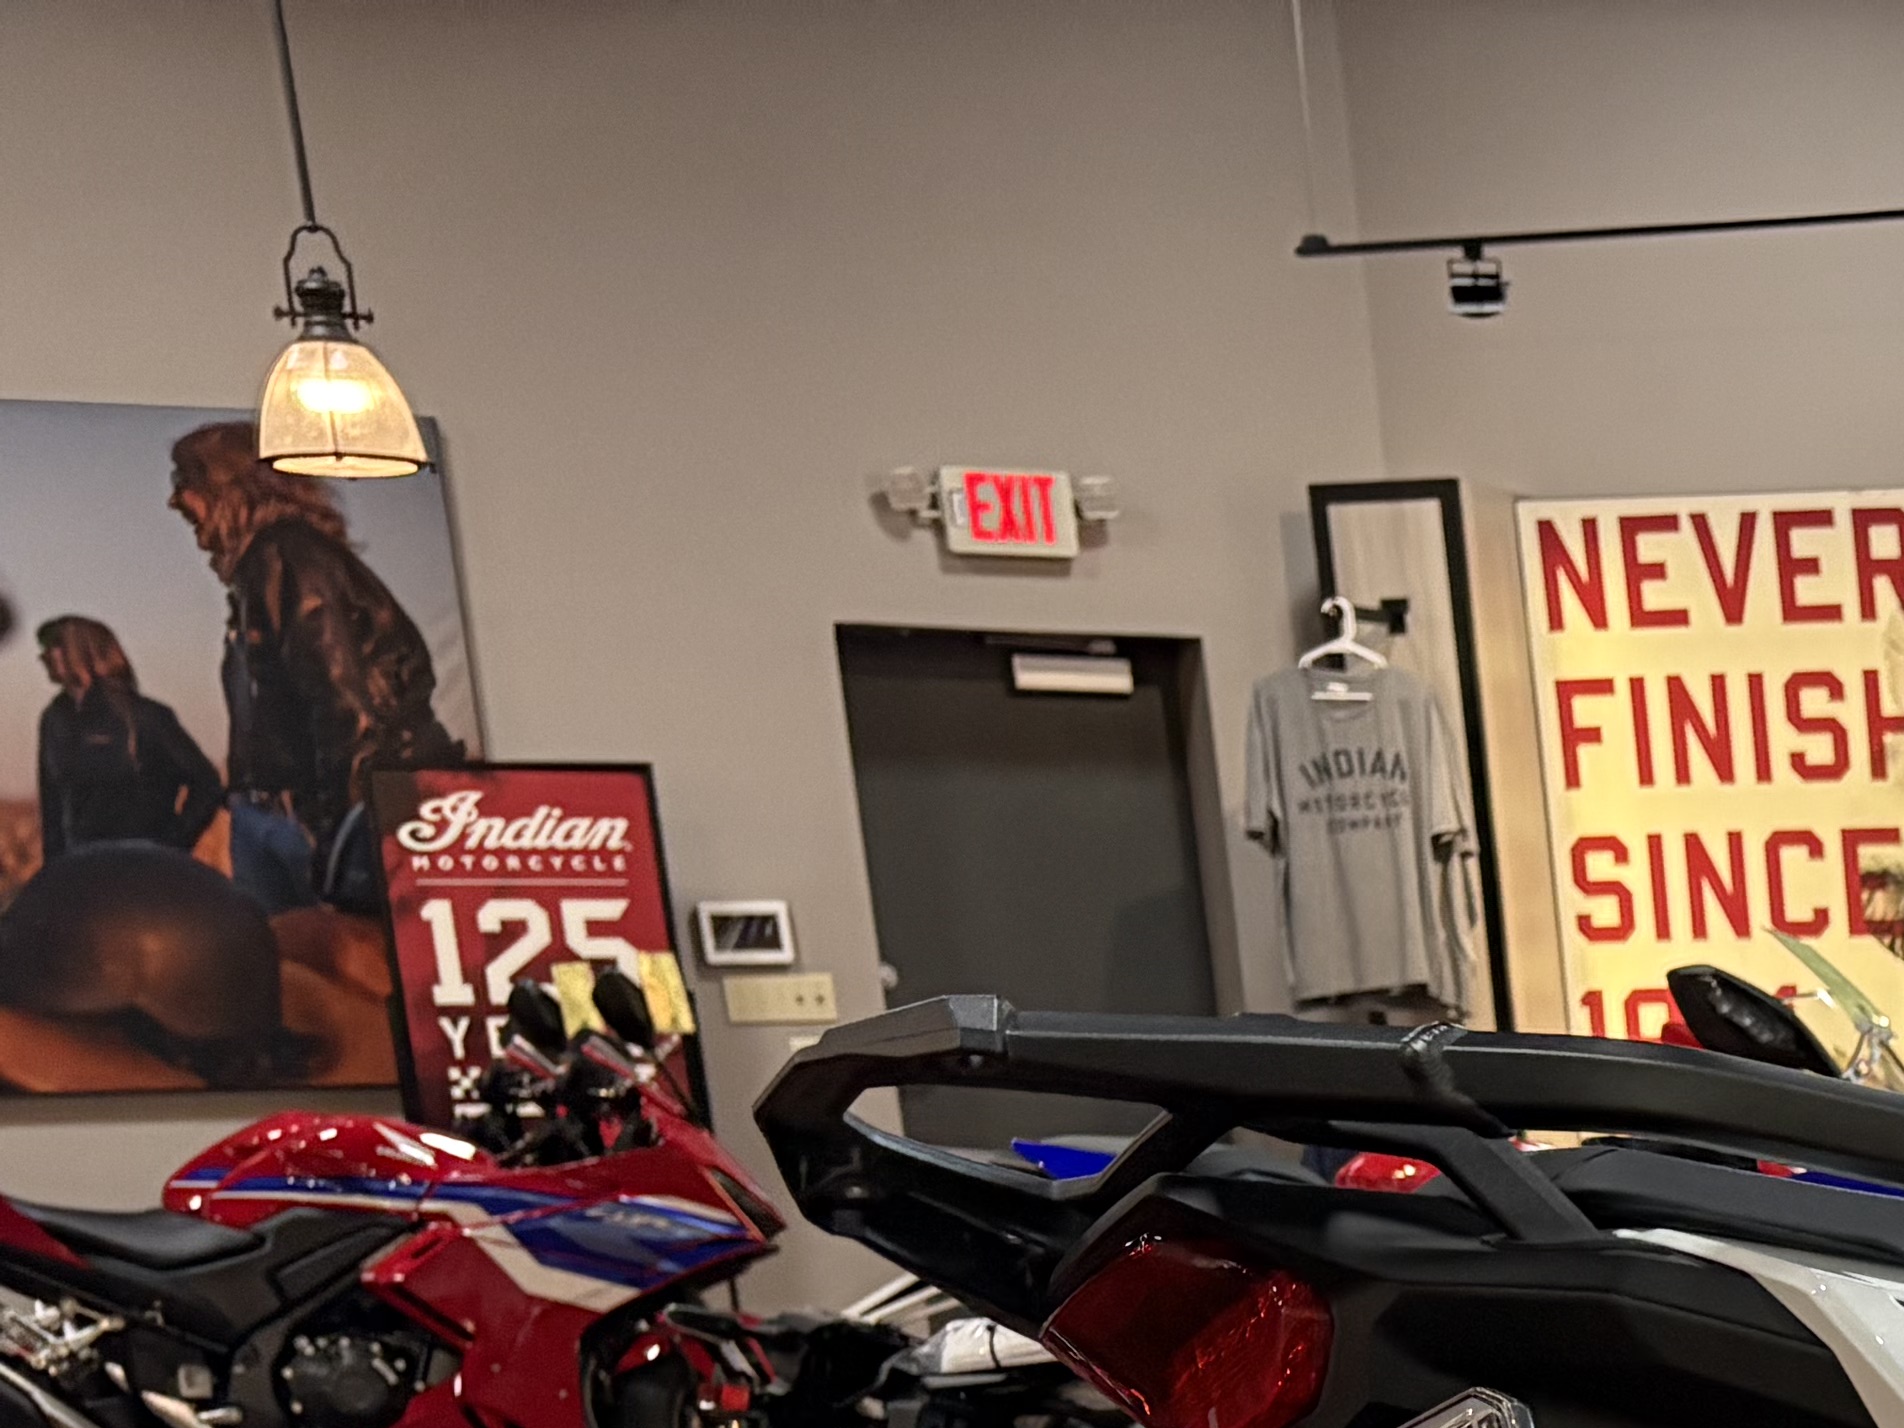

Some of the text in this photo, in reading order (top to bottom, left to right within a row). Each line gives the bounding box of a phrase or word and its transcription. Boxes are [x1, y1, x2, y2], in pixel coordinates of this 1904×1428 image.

[963, 472, 1058, 545] EXIT
[397, 790, 629, 852] Indian
[411, 855, 628, 872] MOTORCYCLE
[1570, 828, 1904, 944] SINCE
[419, 898, 640, 1006] 125
